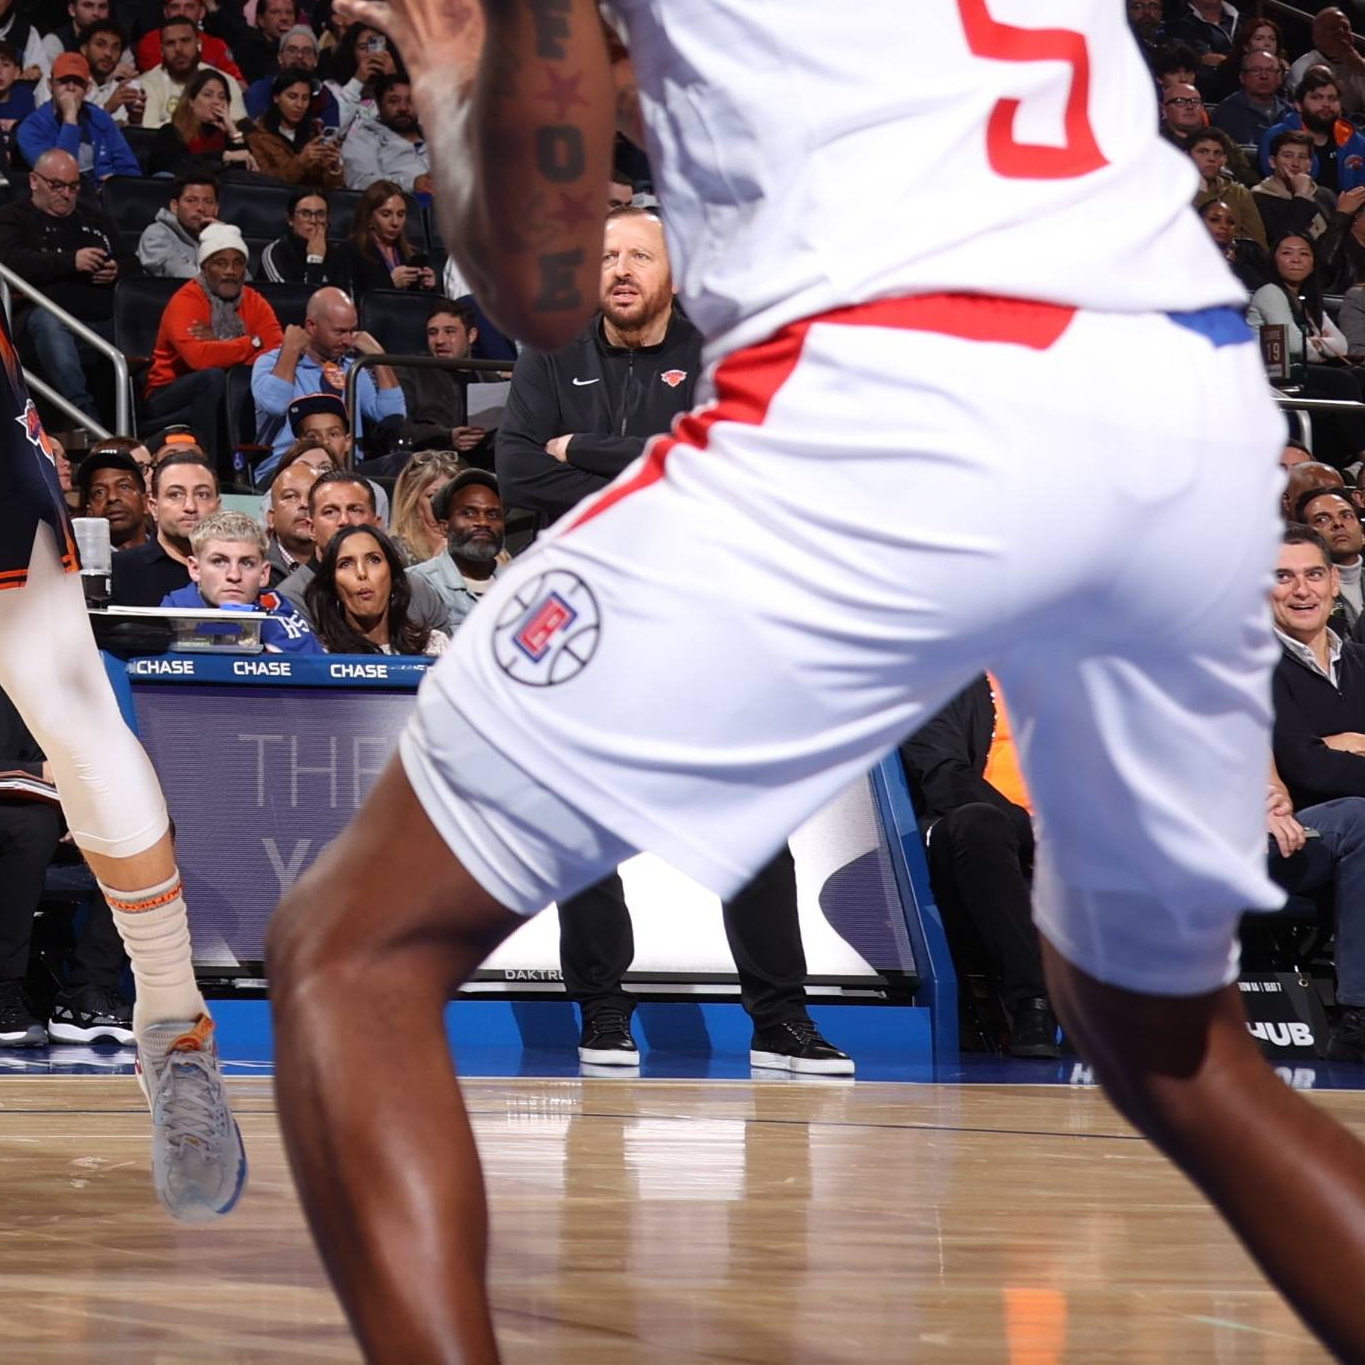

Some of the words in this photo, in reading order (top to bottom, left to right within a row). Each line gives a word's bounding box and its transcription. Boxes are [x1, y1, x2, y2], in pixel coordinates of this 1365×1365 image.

[136, 659, 194, 675] CHASE
[233, 661, 292, 677] CHASE
[330, 663, 388, 679] CHASE
